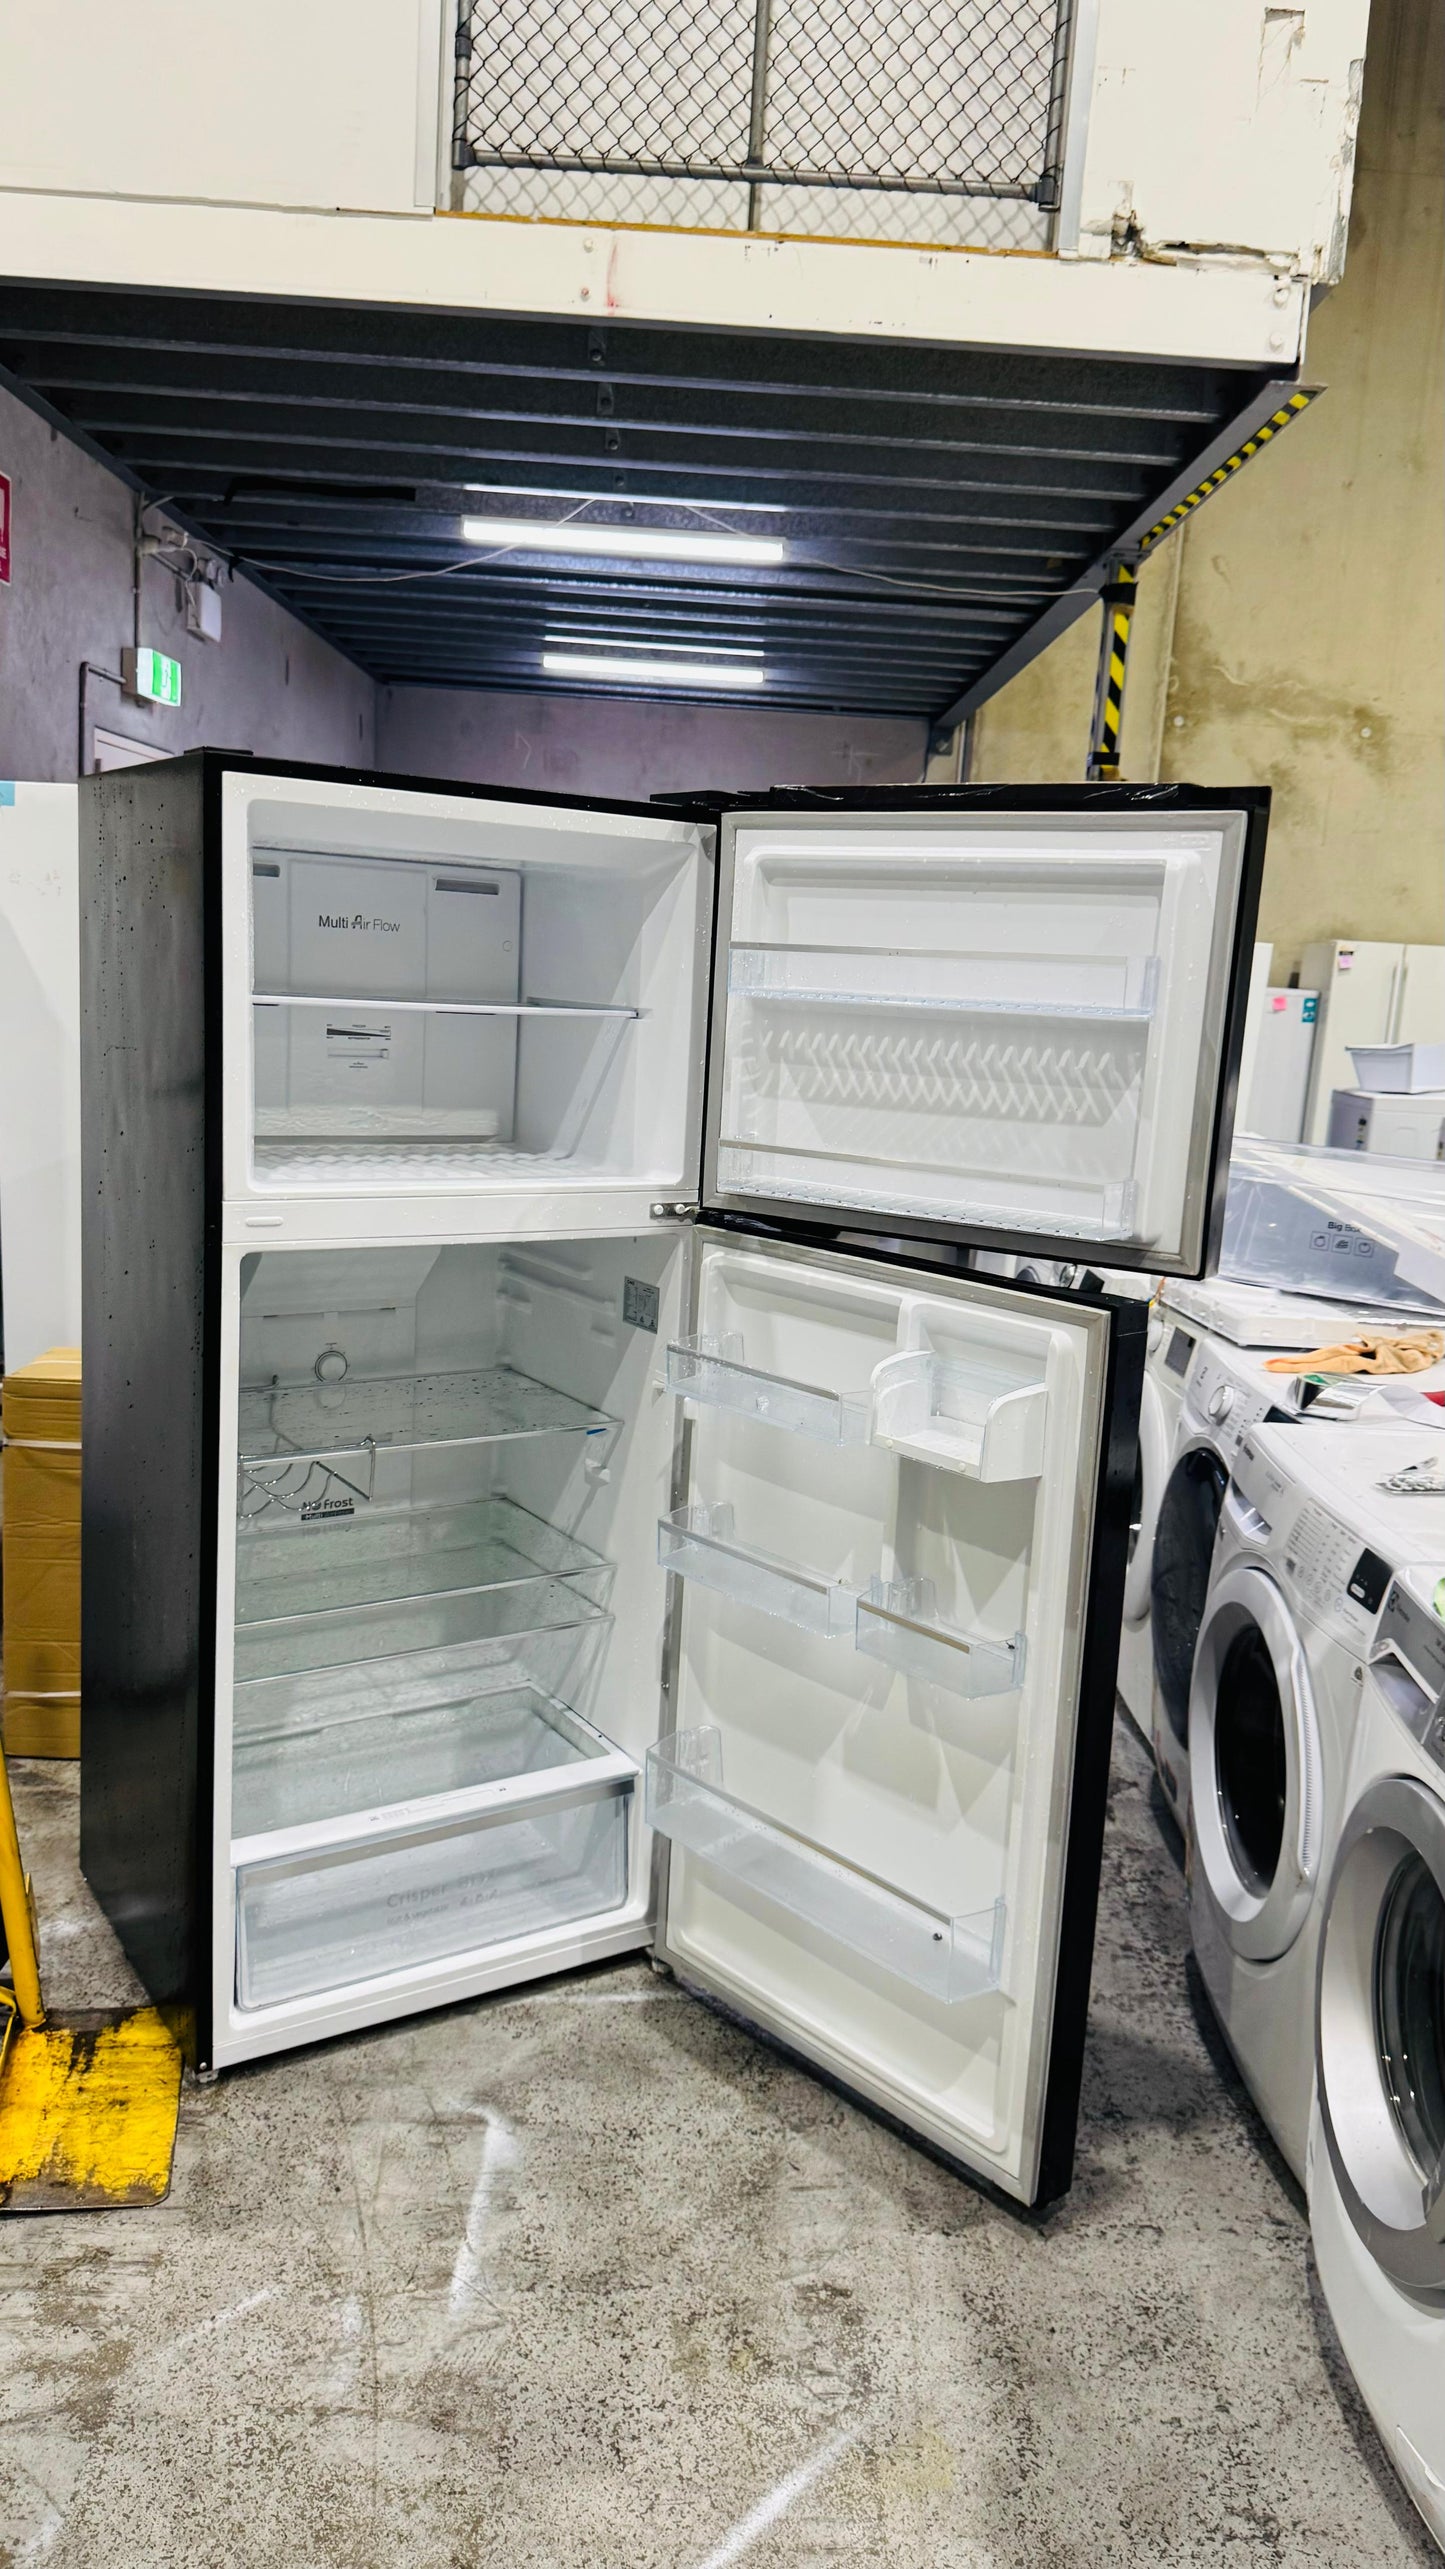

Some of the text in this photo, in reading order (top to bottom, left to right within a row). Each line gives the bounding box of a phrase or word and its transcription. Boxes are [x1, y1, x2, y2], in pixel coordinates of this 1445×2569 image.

[318, 914, 401, 932] Multi Air Flow
[1327, 1221, 1343, 1232] Big
[324, 1497, 354, 1510] Frost
[386, 1883, 447, 1908] Crisper
